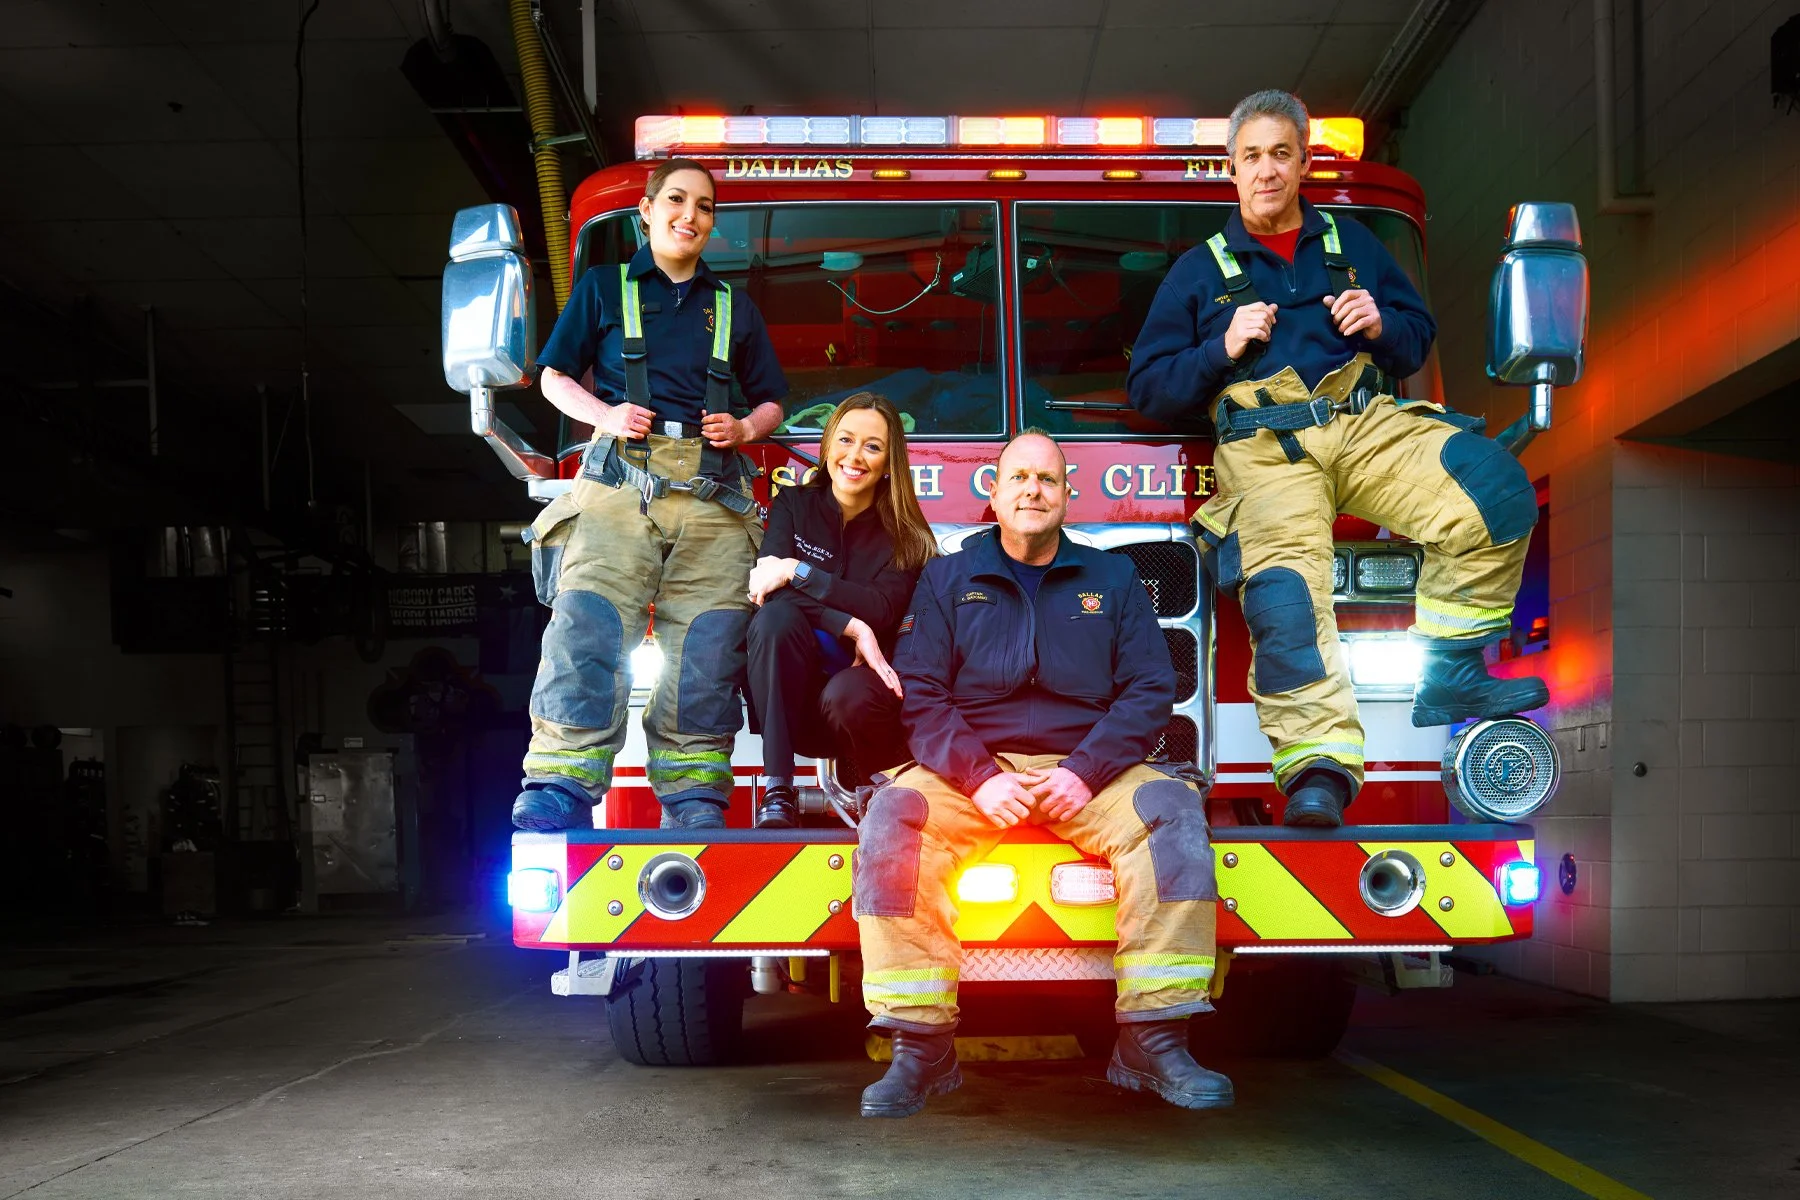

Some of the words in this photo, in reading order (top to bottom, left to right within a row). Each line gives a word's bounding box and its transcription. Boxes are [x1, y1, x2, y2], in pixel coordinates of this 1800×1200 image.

[725, 159, 854, 179] DALLAS
[1184, 159, 1231, 180] FI
[1103, 464, 1215, 498] CLIF
[388, 588, 433, 605] NOBODY
[437, 584, 476, 604] CARES
[1077, 592, 1104, 600] DALLAS
[430, 606, 478, 626] HARDER
